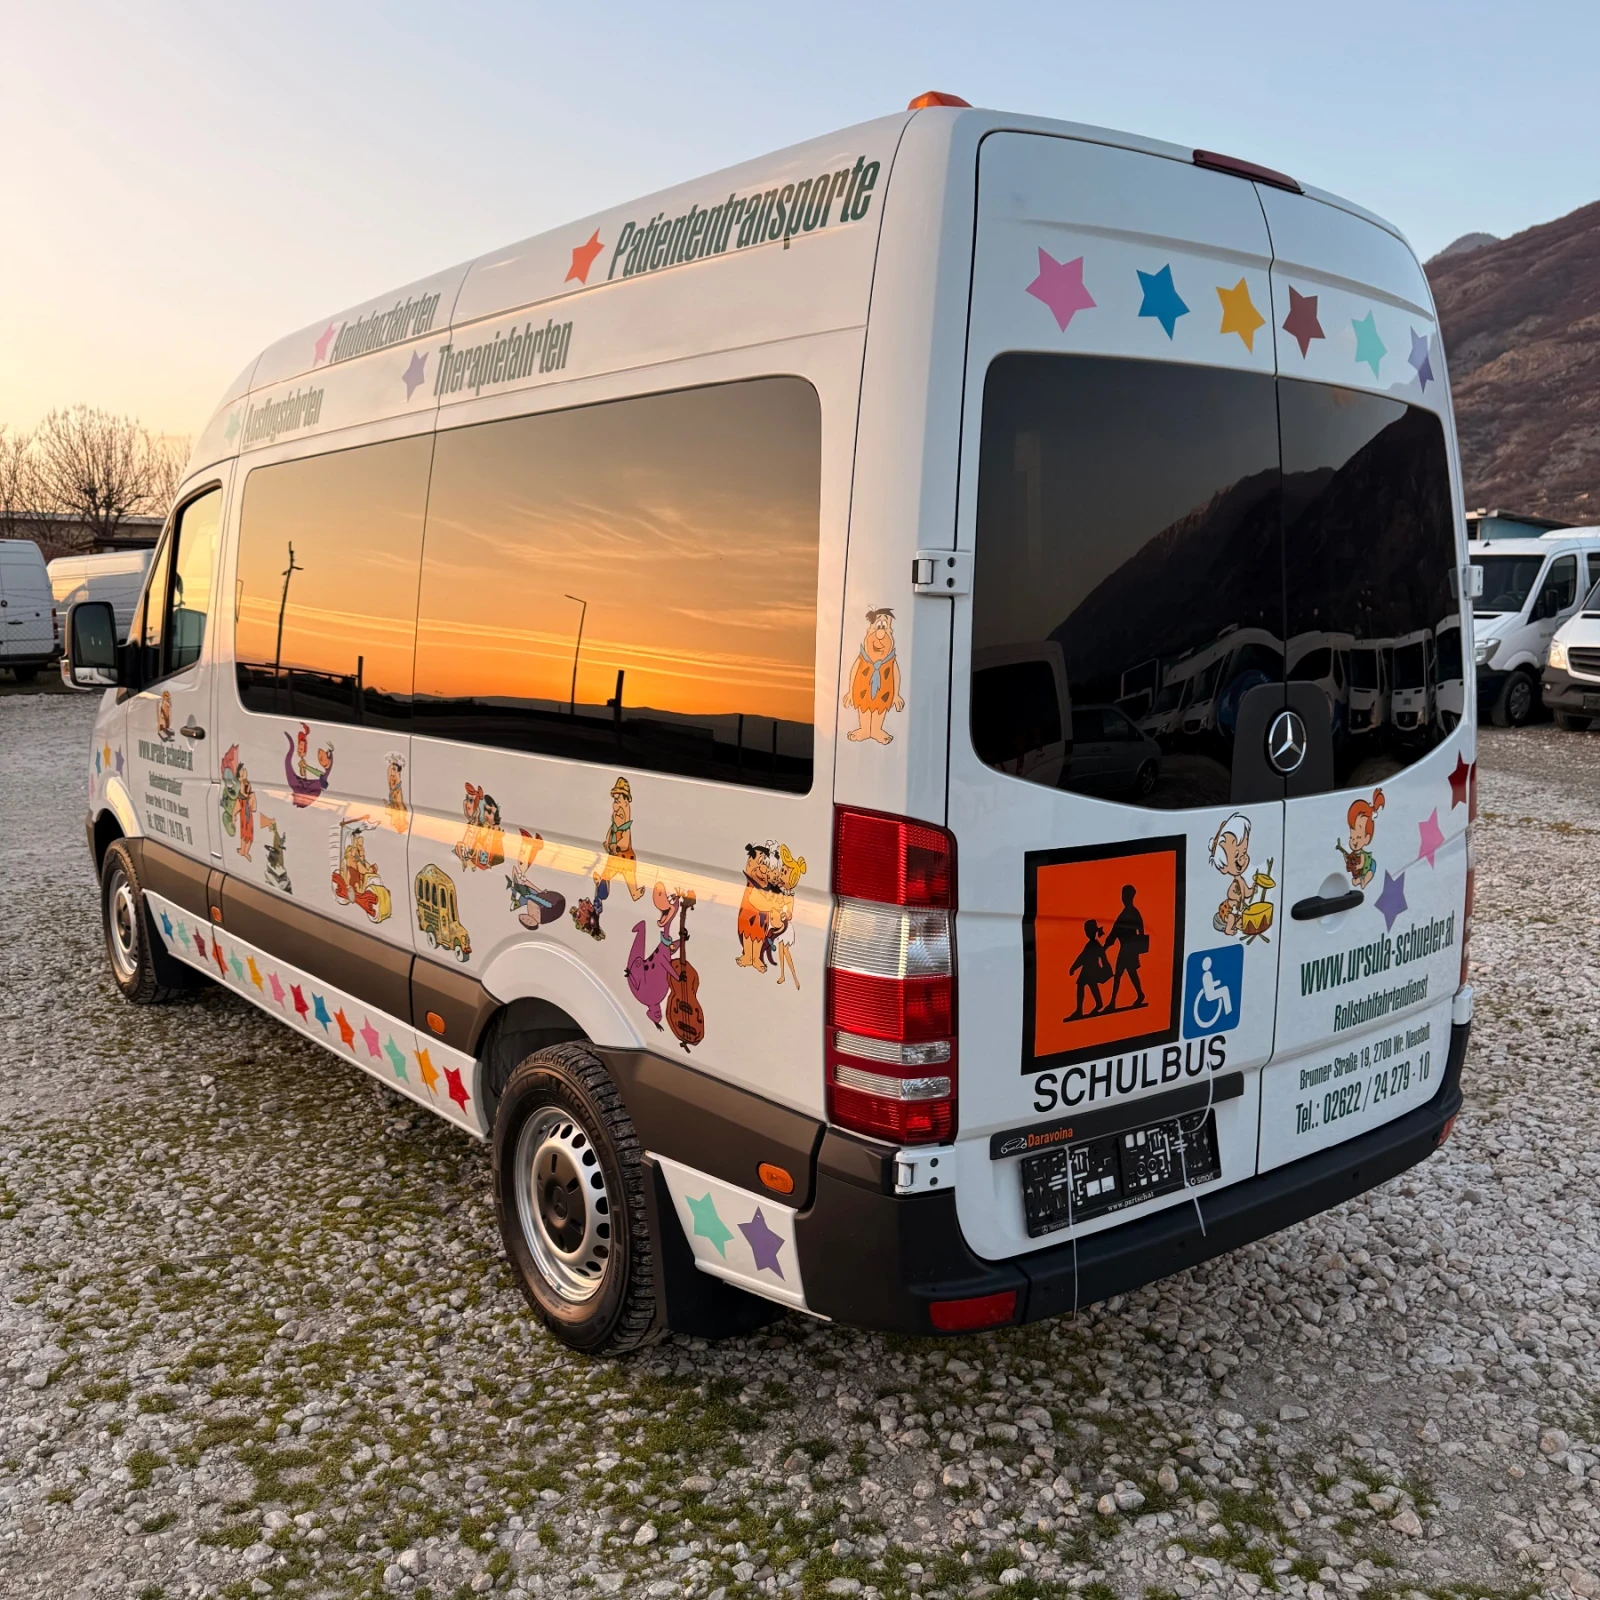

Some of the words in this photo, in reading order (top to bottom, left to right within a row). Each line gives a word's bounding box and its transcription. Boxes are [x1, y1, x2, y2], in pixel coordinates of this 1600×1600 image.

[607, 155, 881, 281] Patiententransporte
[329, 292, 441, 364] Ambulanzfahrten
[433, 319, 574, 397] Therapiefahrten
[242, 386, 325, 448] Ausflugsfahrten
[1300, 910, 1455, 997] www.ursula-schueler.at
[1333, 974, 1429, 1033] Rollstuhlfahrtendienst
[1033, 1035, 1227, 1113] SCHULBUS
[1296, 1100, 1320, 1135] Tel.:
[1323, 1081, 1362, 1124] 02622
[1362, 1076, 1372, 1112] /
[1373, 1071, 1388, 1103] 24
[1390, 1061, 1411, 1096] 279
[1418, 1051, 1430, 1082] 10
[1300, 1064, 1332, 1091] Brunner
[1333, 1052, 1358, 1079] Straße
[1360, 1046, 1372, 1069] 19,
[1373, 1038, 1392, 1063] 2700
[1393, 1034, 1404, 1055] Wr.
[1405, 1022, 1431, 1049] Neustadt
[1027, 1128, 1073, 1147] Daravoina
